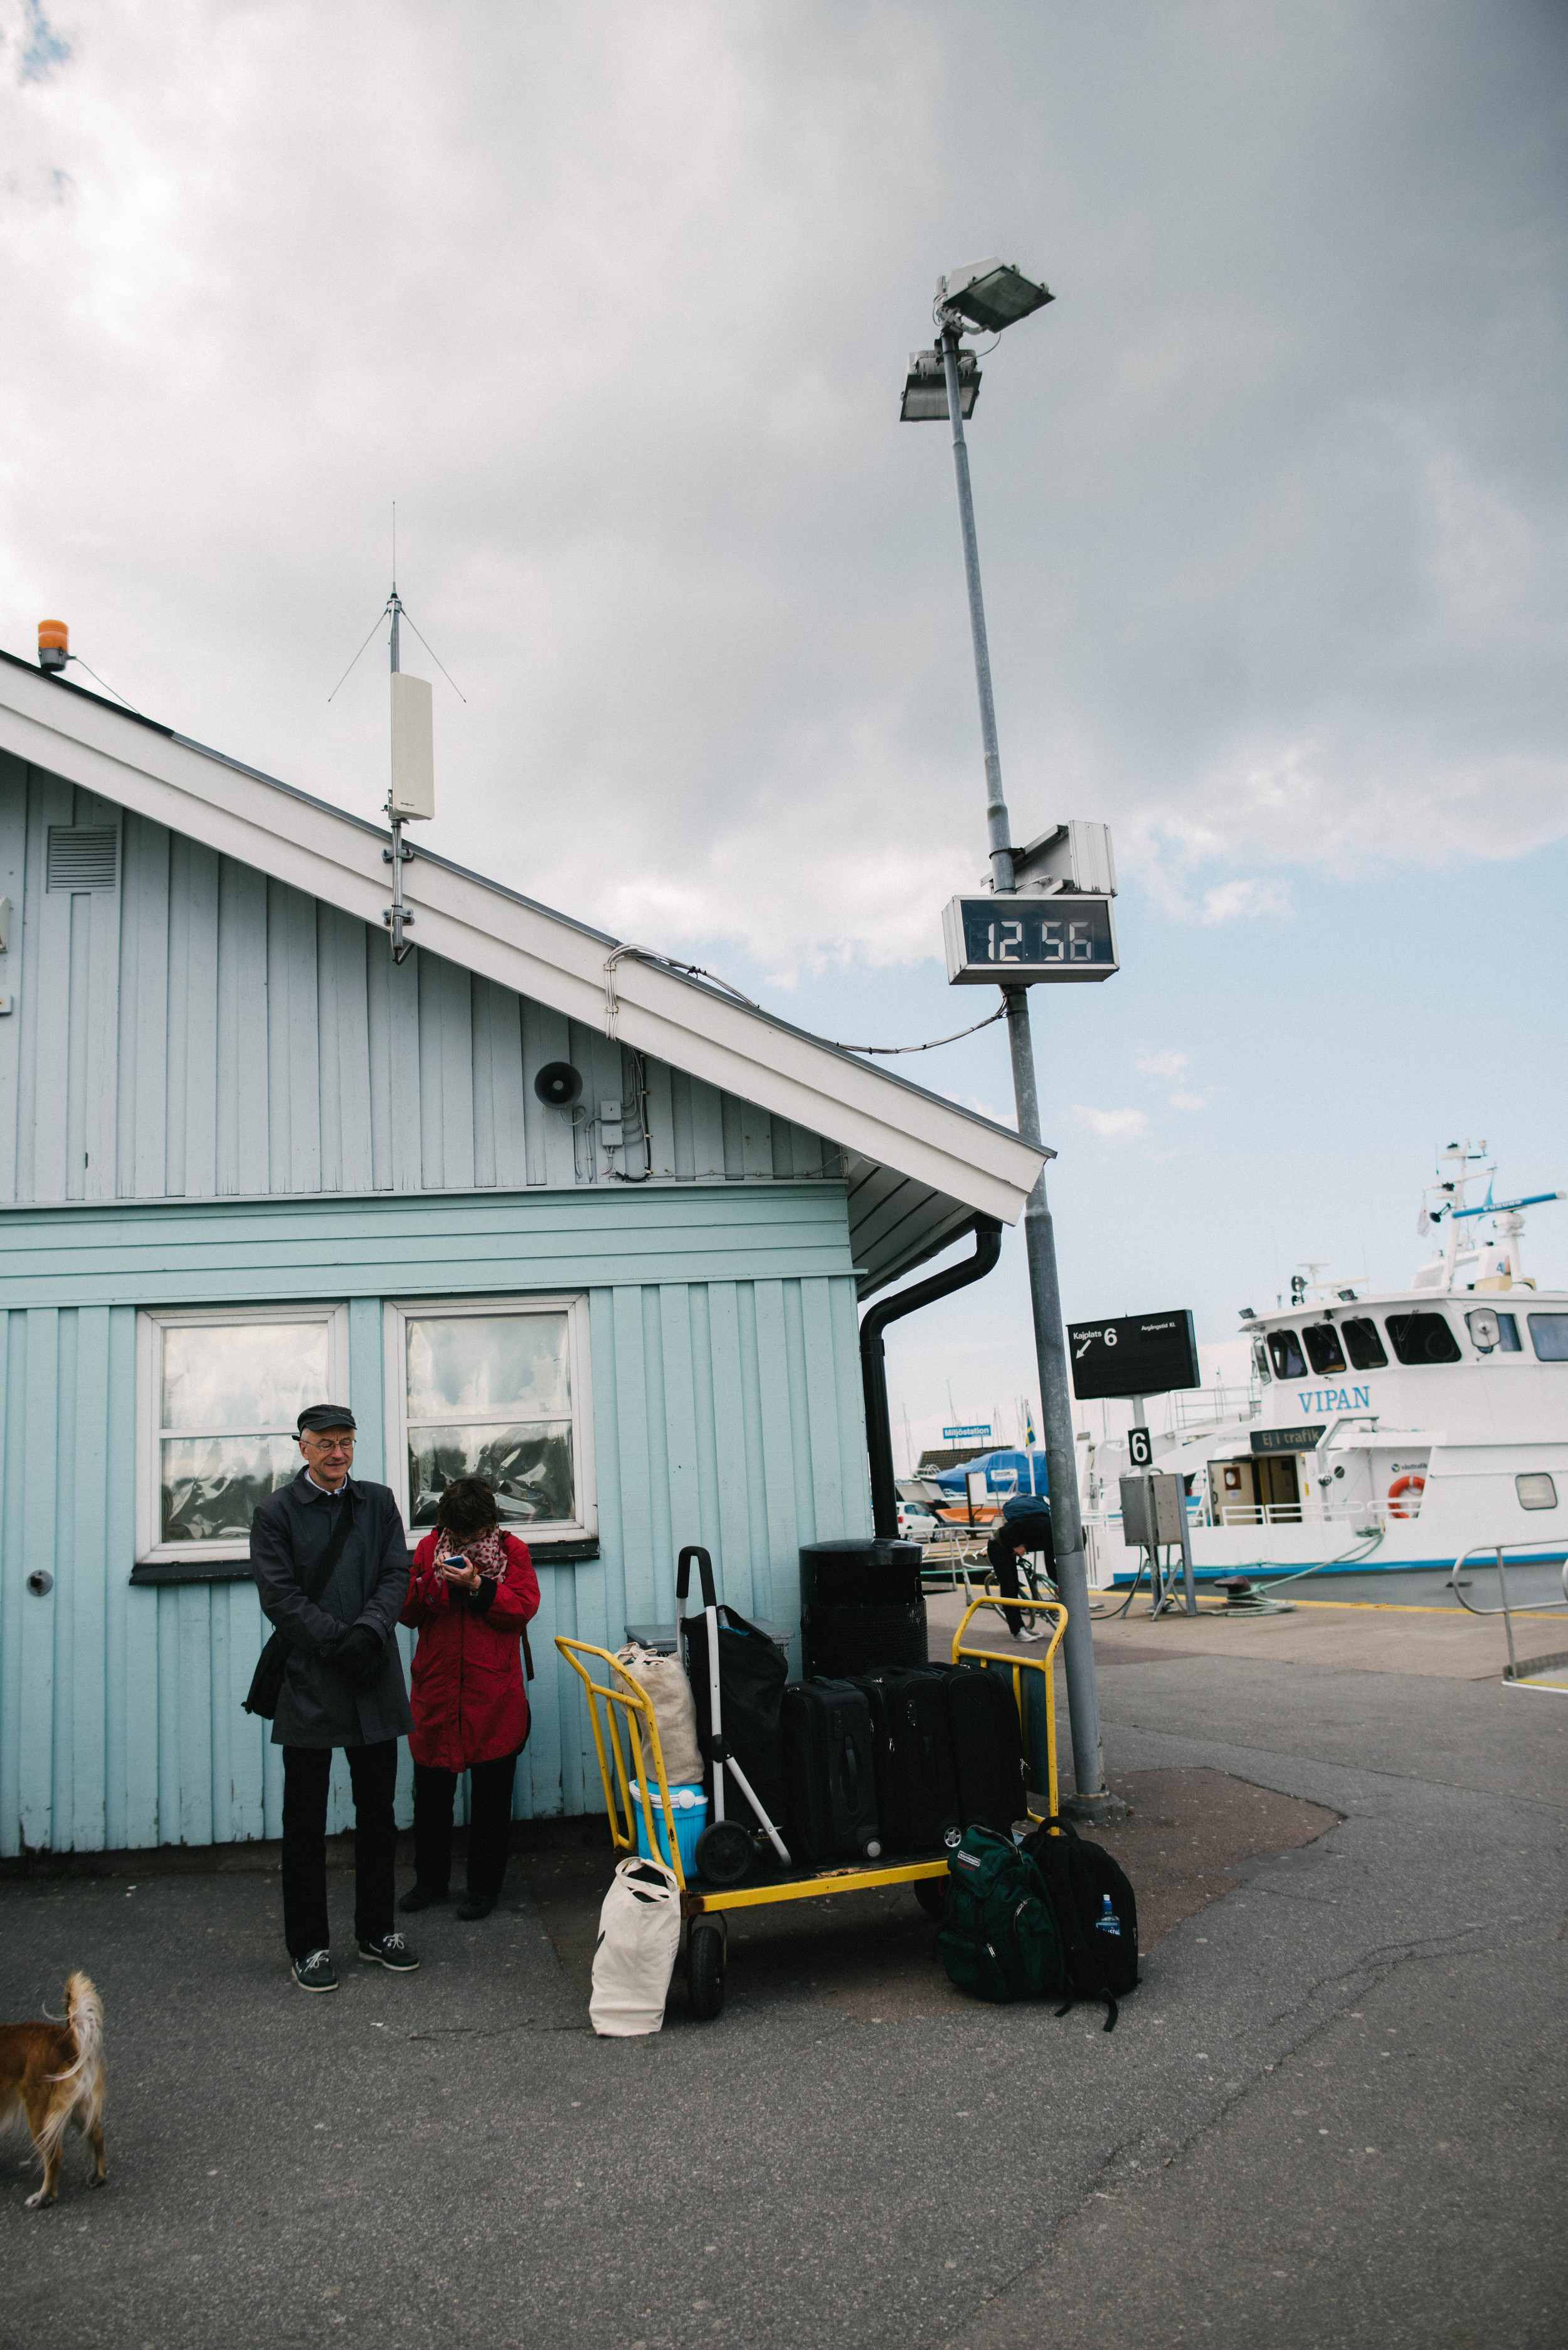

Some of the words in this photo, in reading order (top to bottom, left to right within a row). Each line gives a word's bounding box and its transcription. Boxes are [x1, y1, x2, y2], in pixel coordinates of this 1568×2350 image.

[1483, 1200, 1522, 1211] FURUNO
[1073, 1331, 1103, 1341] Kajplats
[1104, 1327, 1118, 1346] 6
[1141, 1323, 1168, 1331] Avgångstid
[1297, 1385, 1370, 1414] VIPAN
[944, 1427, 990, 1438] Miljöstation
[1261, 1432, 1273, 1449] Ej
[1284, 1428, 1320, 1443] trafik
[1131, 1432, 1148, 1462] 6
